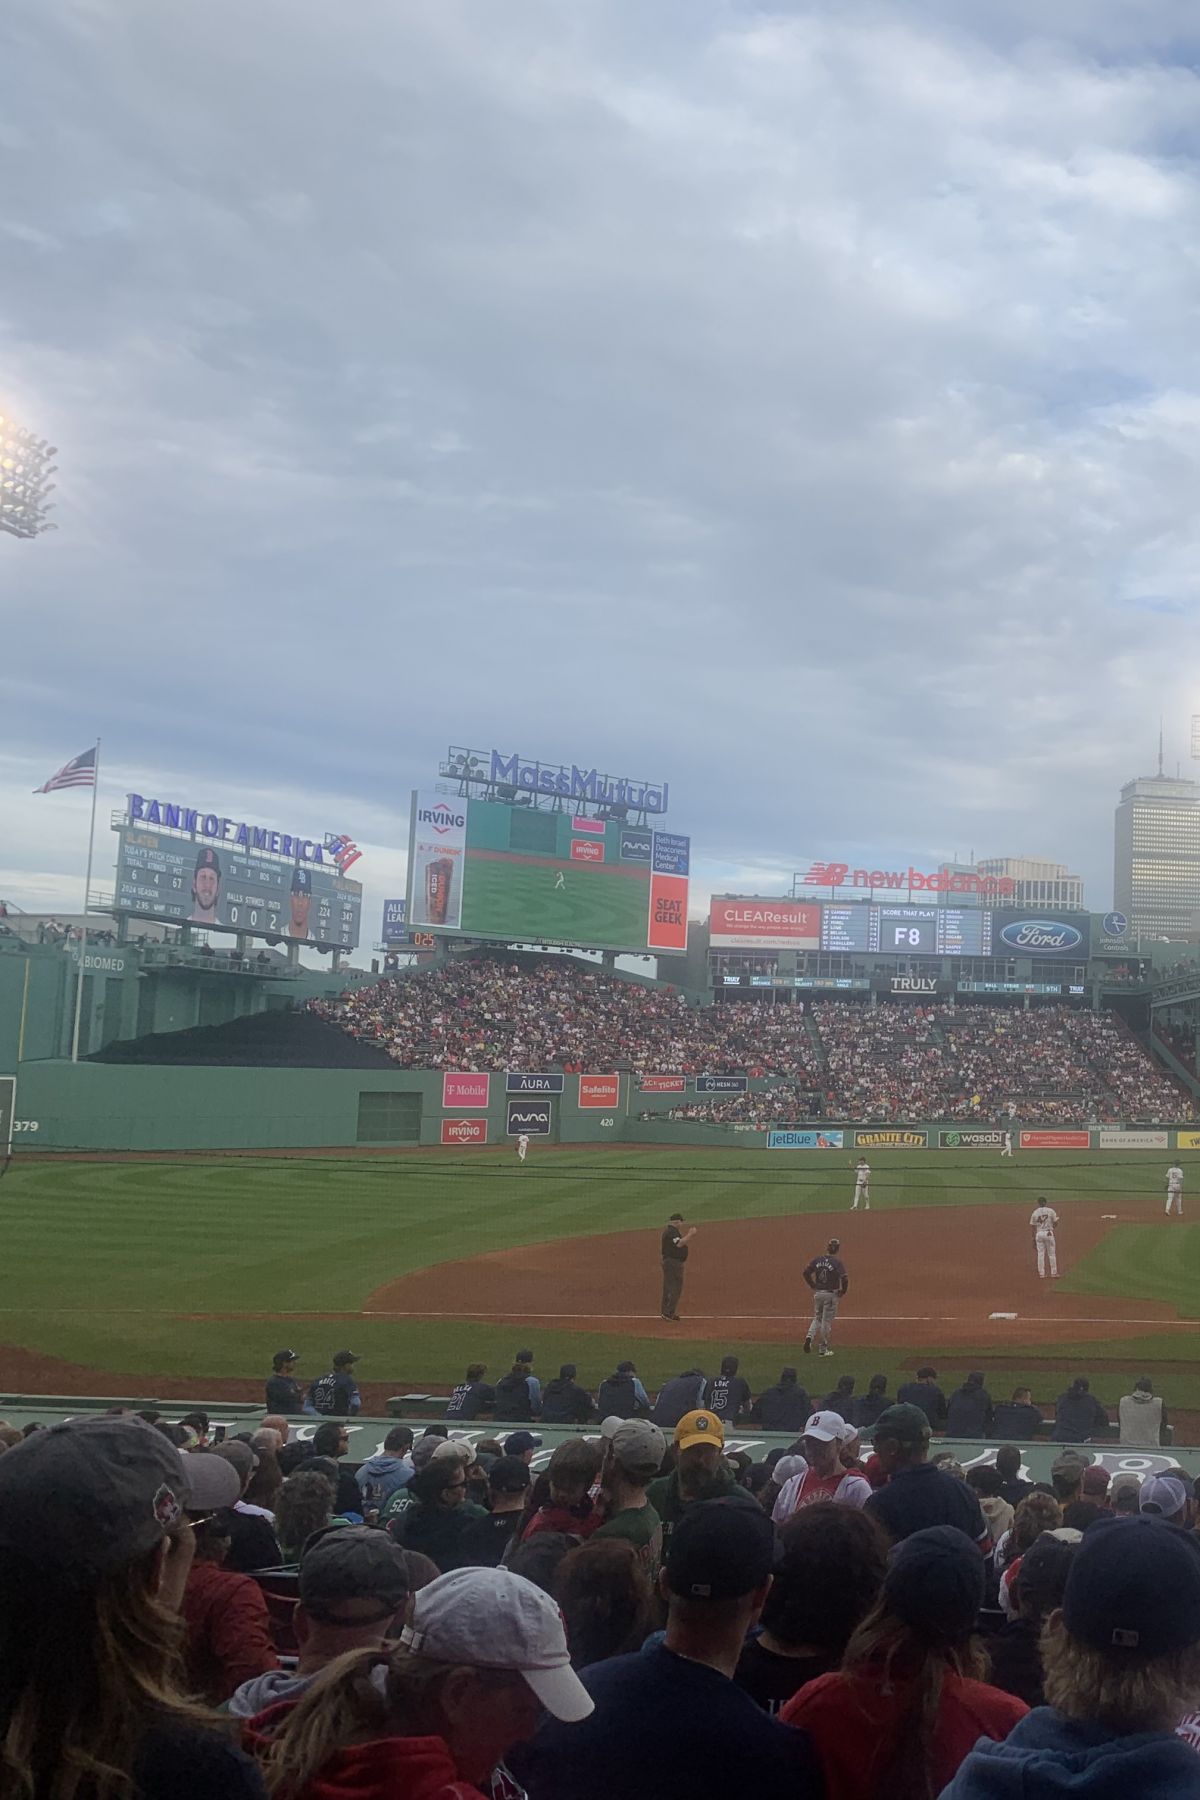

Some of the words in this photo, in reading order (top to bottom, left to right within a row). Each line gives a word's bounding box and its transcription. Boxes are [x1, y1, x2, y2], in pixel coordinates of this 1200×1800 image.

[489, 749, 668, 815] MassMutual
[418, 809, 464, 827] IRVING
[126, 793, 198, 832] BANK
[201, 813, 233, 842] OF
[234, 822, 324, 865] AMERICA
[149, 850, 167, 861] PITCH
[656, 854, 679, 863] Medical
[127, 858, 144, 868] TOTAL
[655, 862, 675, 870] Center
[230, 866, 237, 874] TB
[131, 871, 137, 880] 6
[153, 874, 159, 884] 4
[172, 878, 182, 889] 67
[853, 870, 905, 889] new
[908, 866, 1018, 895] balance
[138, 887, 159, 898] SEASON
[227, 892, 243, 902] BALLS
[268, 901, 280, 910] OUTS
[656, 898, 682, 912] SEAT
[388, 904, 402, 912] ALL
[231, 907, 238, 922] 0
[250, 911, 257, 926] 0
[269, 914, 276, 929] 2
[655, 911, 682, 925] GEEK
[724, 909, 807, 924] CLEAResult
[894, 927, 921, 946] F8
[1016, 925, 1066, 947] Ford
[891, 977, 937, 990] TRULY
[456, 1085, 486, 1096] Mobile
[582, 1085, 616, 1094] Safelite
[659, 1080, 684, 1089] TICKET
[511, 1114, 549, 1122] nuna
[600, 1118, 614, 1127] 420
[13, 1121, 39, 1132] 379
[448, 1127, 480, 1136] IRVING
[773, 1132, 811, 1145] jetBlue
[857, 1133, 902, 1146] GRANITE
[903, 1132, 926, 1145] CITY
[314, 1387, 336, 1409] 24
[447, 1390, 466, 1411] 21
[711, 1389, 728, 1410] 15
